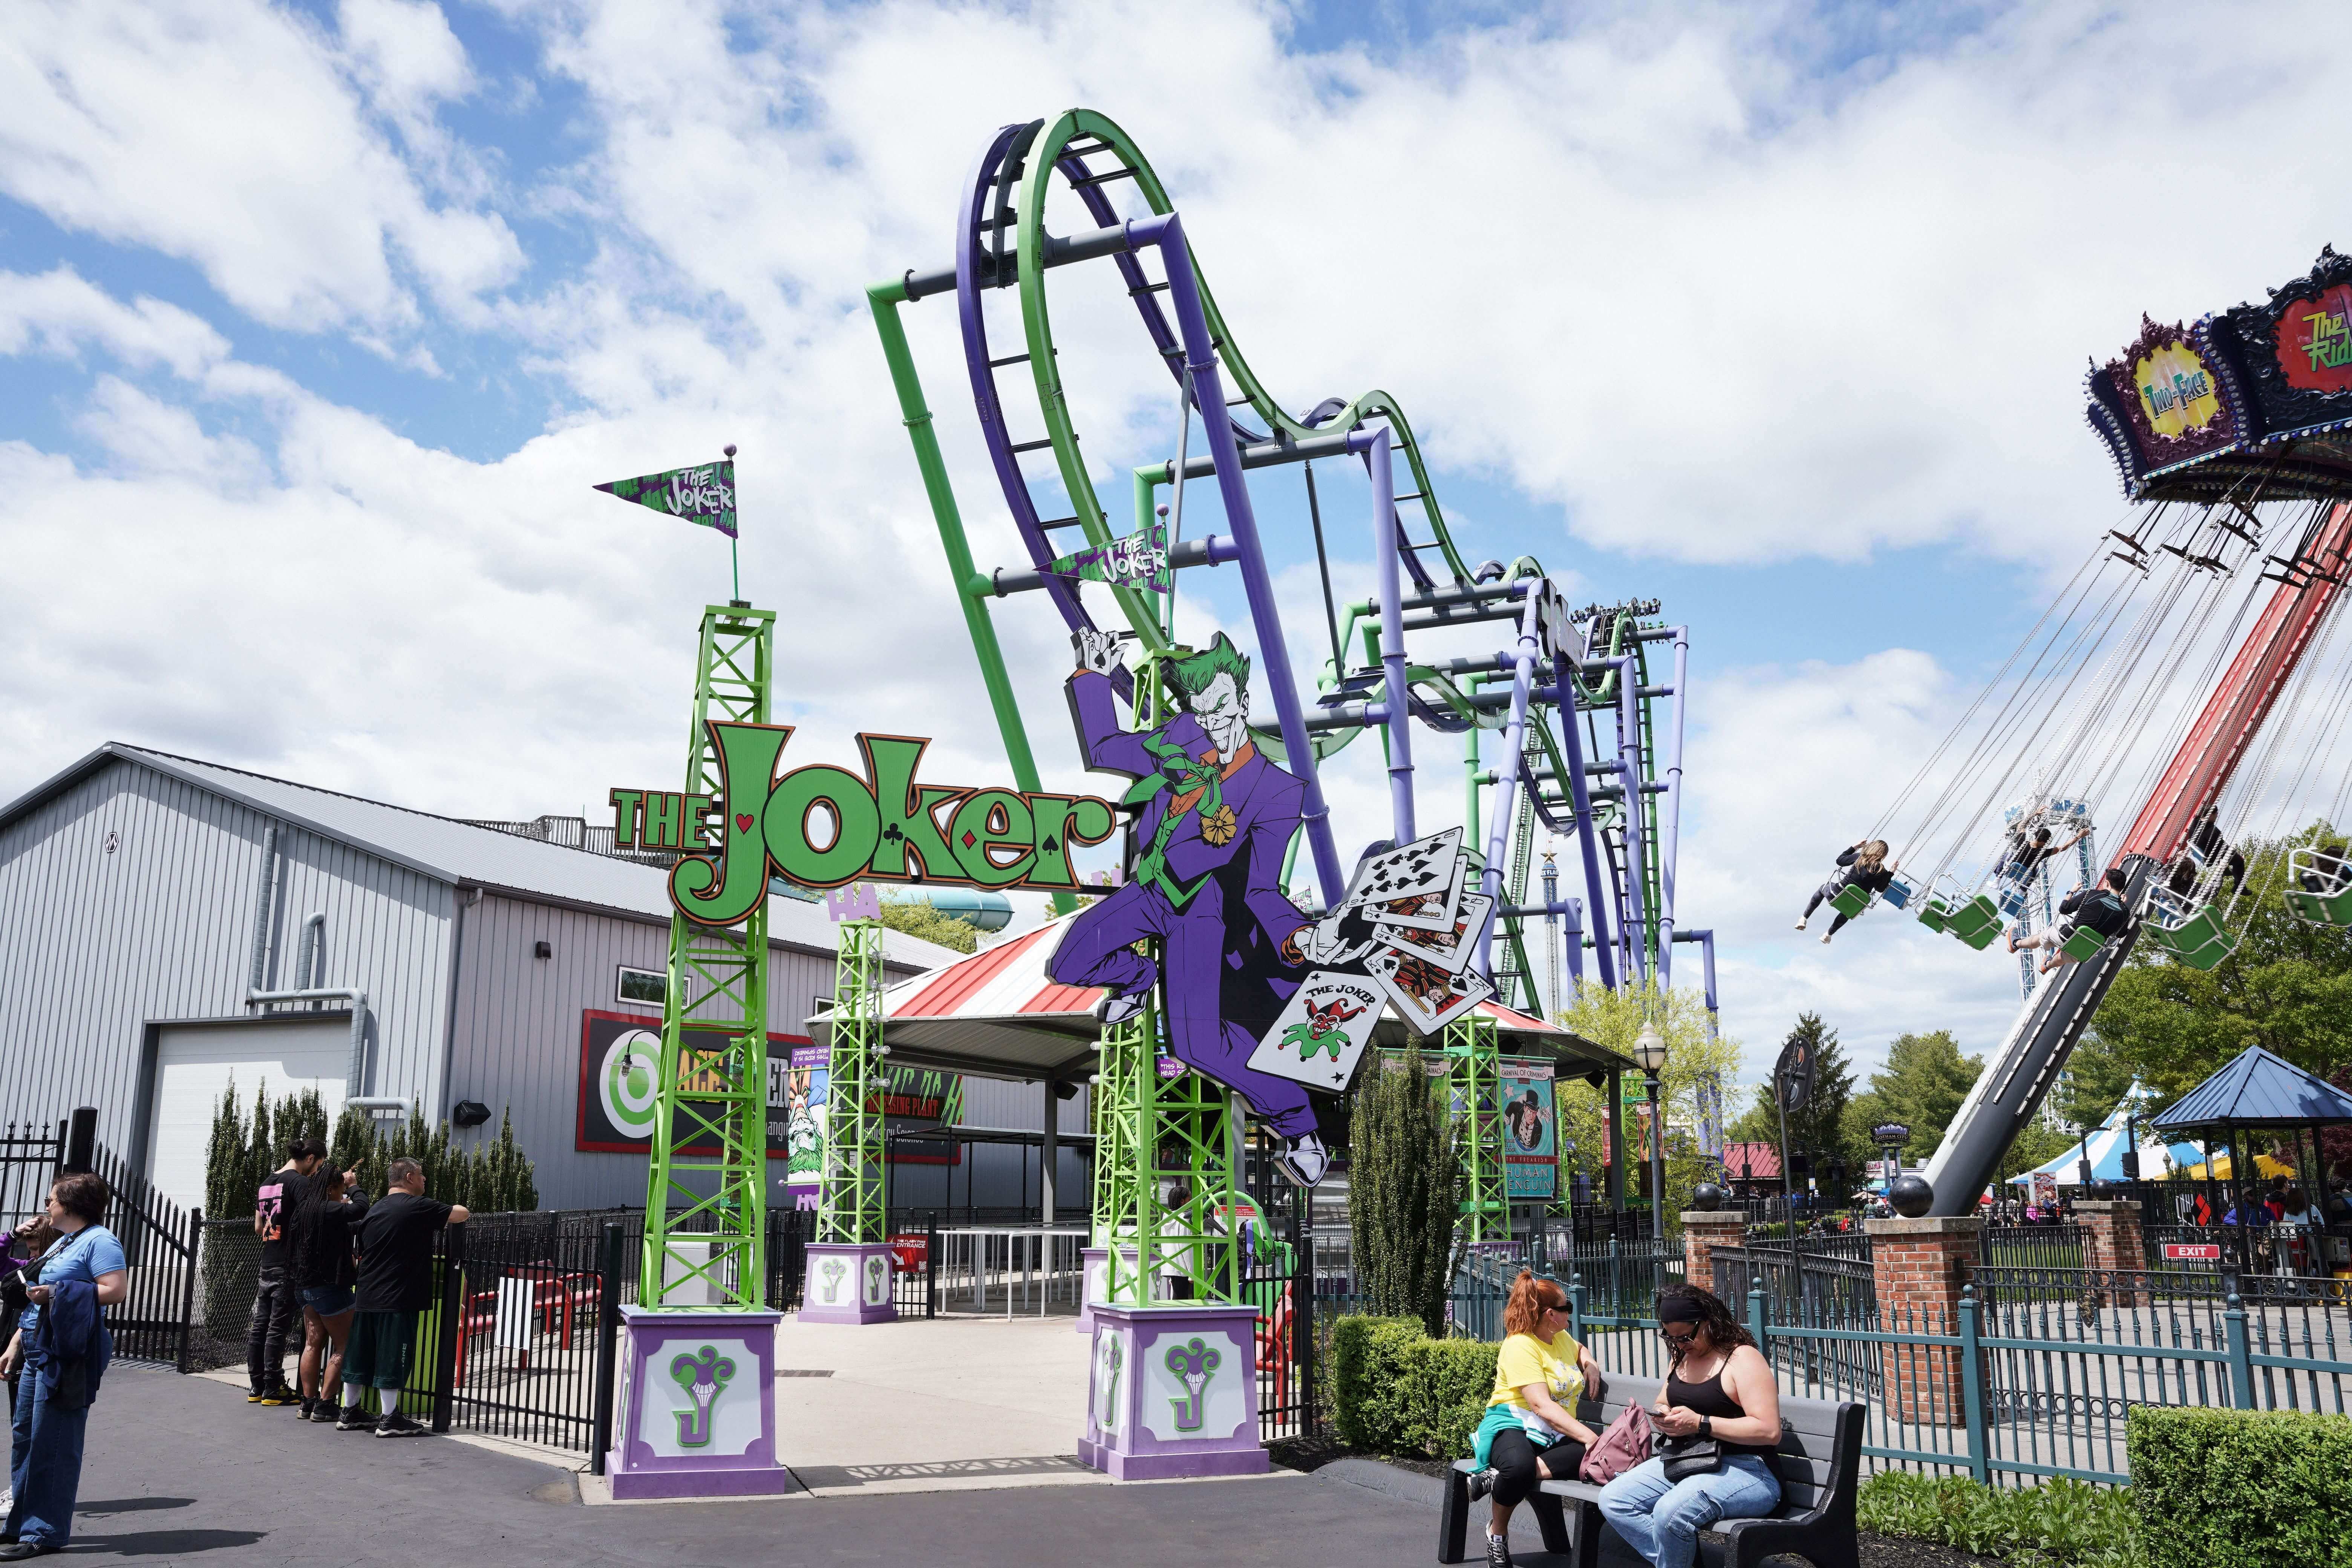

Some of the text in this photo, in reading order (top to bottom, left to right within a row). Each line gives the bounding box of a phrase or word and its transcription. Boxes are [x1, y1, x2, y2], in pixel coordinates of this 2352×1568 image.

[2302, 311, 2342, 341] The
[2301, 326, 2352, 372] Rid
[678, 469, 713, 486] THE
[666, 482, 733, 515] JOKER
[1112, 535, 1145, 554] THE
[1102, 547, 1166, 583] JOKER
[610, 719, 1117, 928] THE Joker
[826, 884, 882, 921] HA
[1291, 894, 1303, 903] THE
[1293, 898, 1312, 910] OKER
[1306, 984, 1376, 1007] THE JOKER
[1476, 982, 1490, 992] K
[867, 1094, 938, 1117] ROCESSING PLANT
[1506, 1167, 1548, 1178] HUMAN
[1508, 1180, 1551, 1191] ENGUIN
[46, 1244, 66, 1258] adidas
[2178, 1247, 2207, 1256] EXIT
